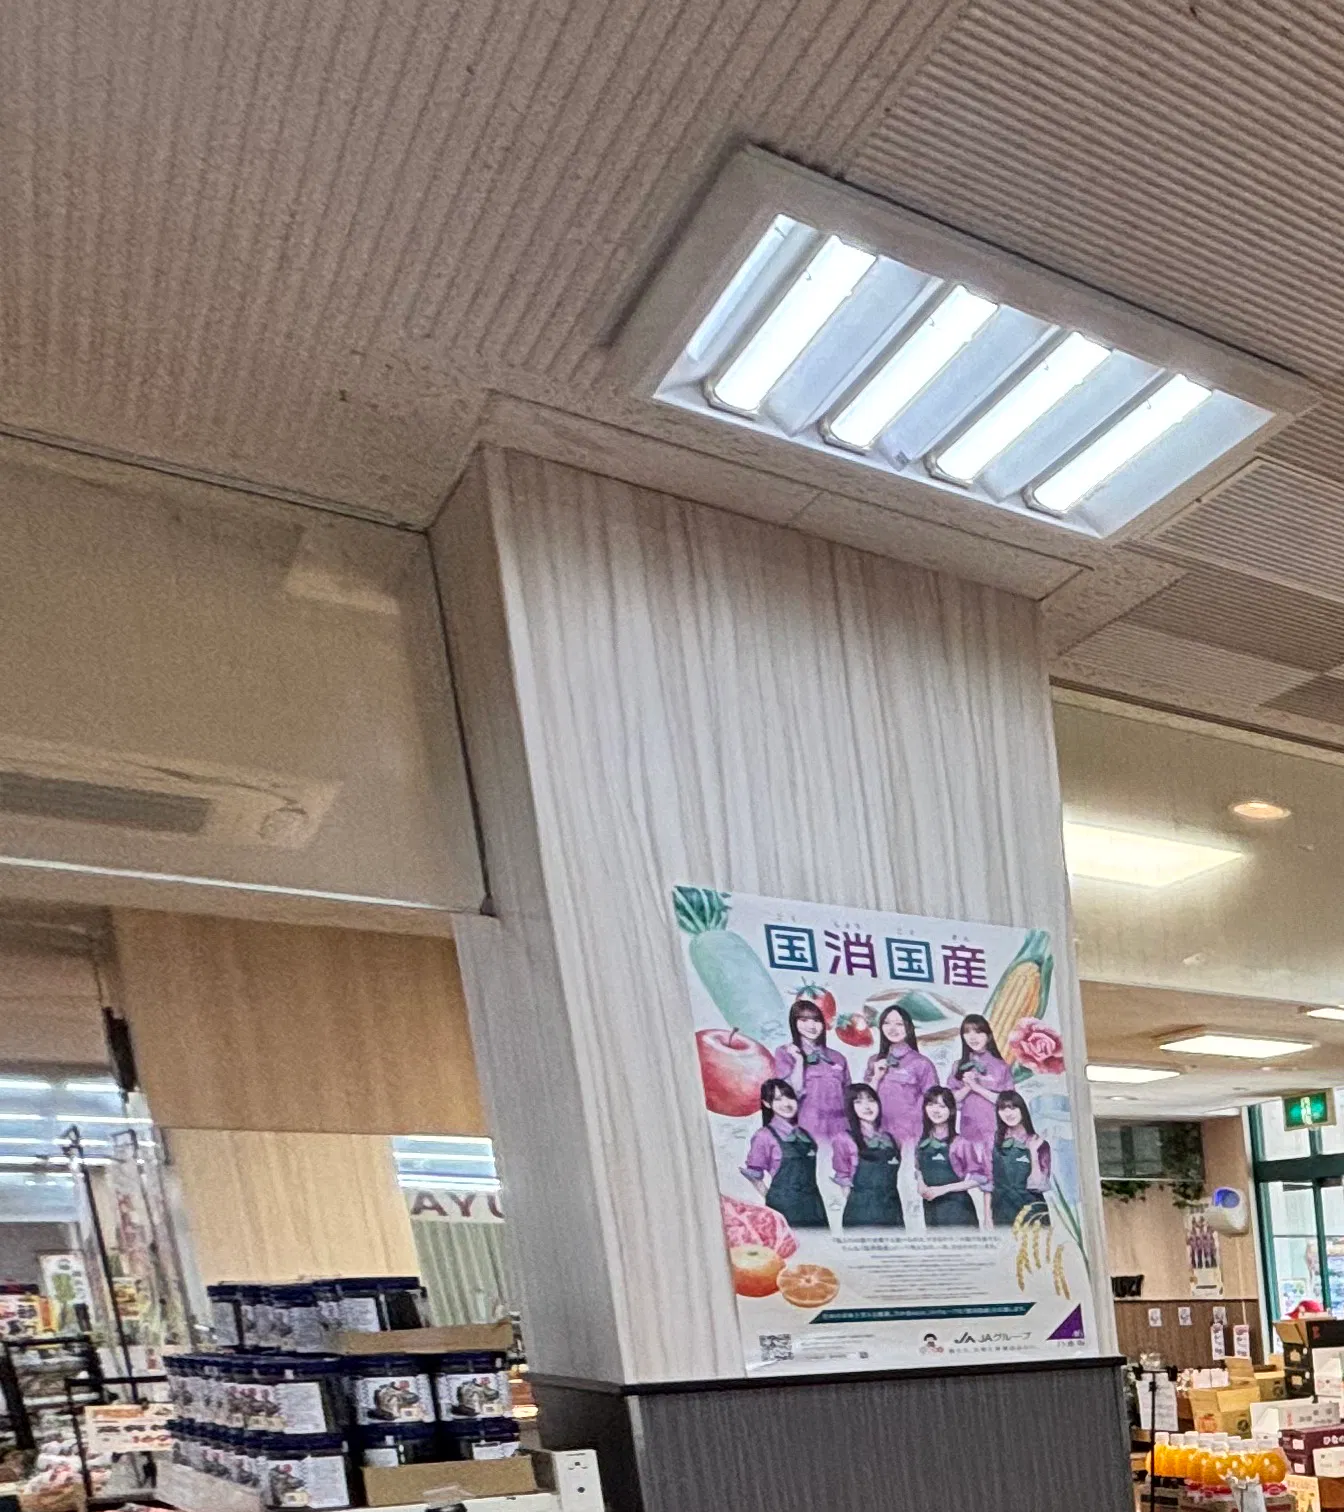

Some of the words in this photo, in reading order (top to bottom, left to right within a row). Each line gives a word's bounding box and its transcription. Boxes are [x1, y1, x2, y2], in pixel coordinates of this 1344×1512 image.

[764, 923, 989, 988] 国消国産
[978, 1331, 1033, 1344] JAグループ
